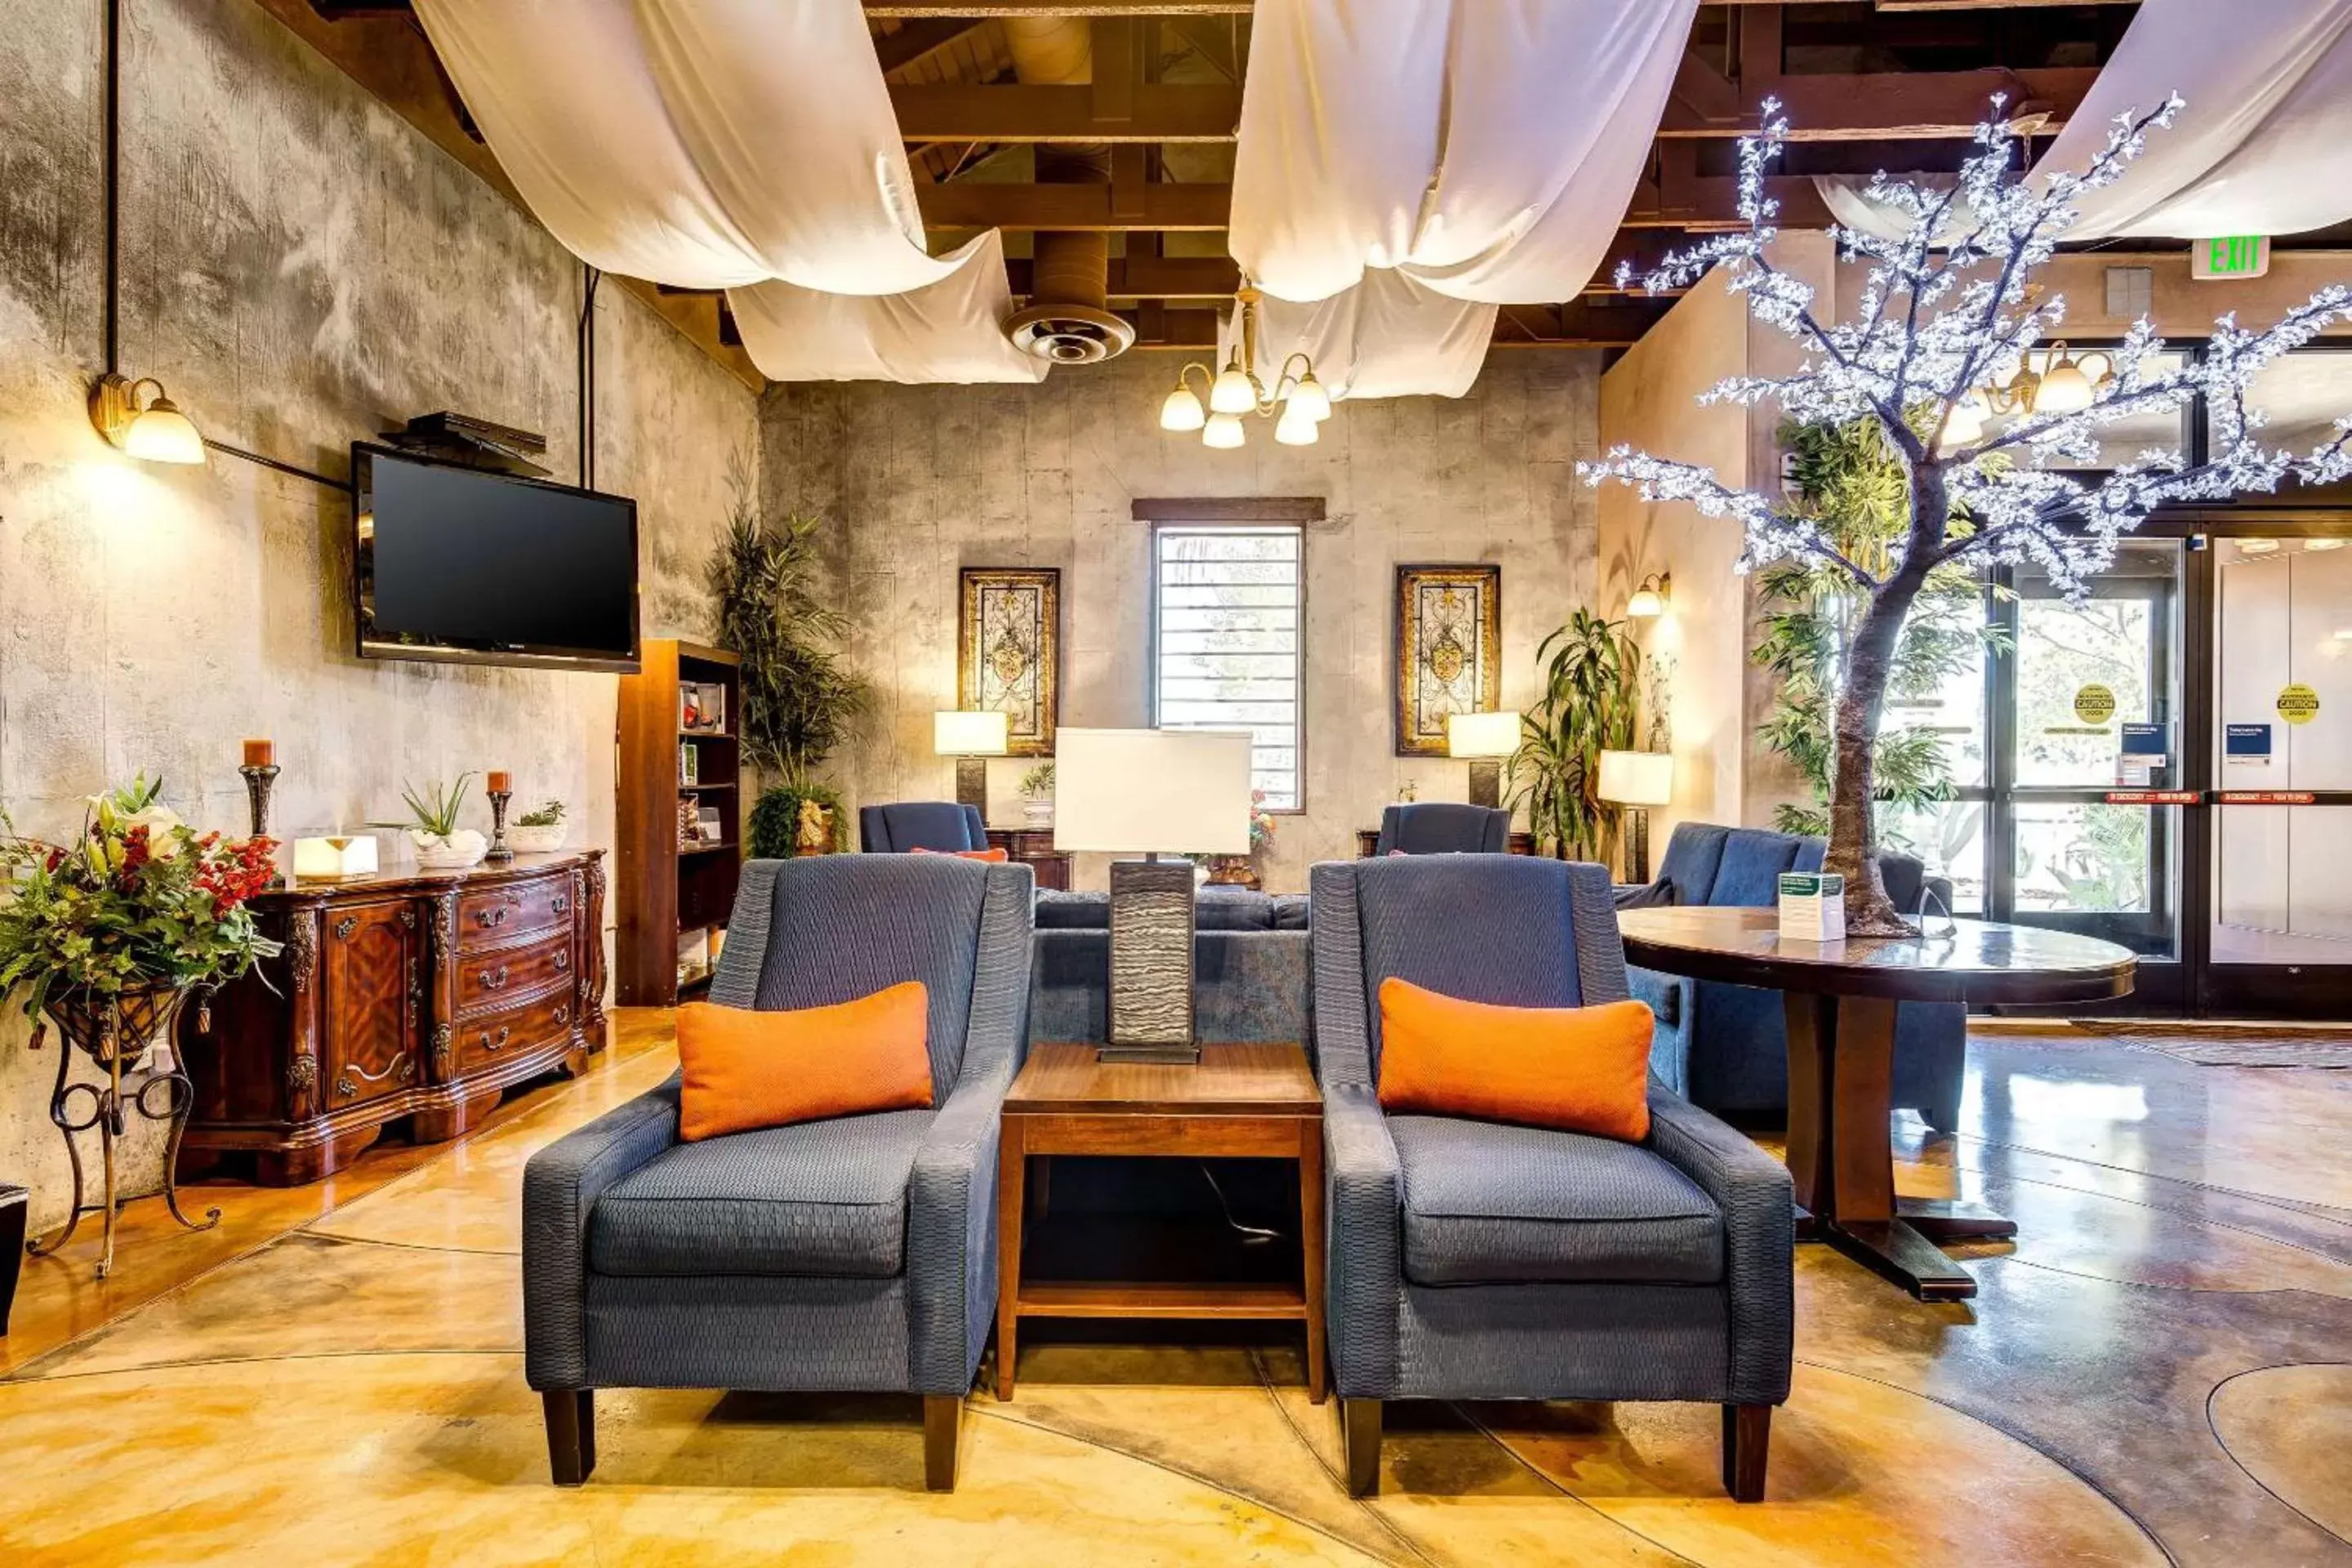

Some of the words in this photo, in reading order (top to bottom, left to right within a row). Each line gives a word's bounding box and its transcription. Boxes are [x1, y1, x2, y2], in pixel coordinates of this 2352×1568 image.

[2210, 236, 2260, 273] EXIT
[2077, 699, 2112, 708] CAUTION
[2280, 700, 2316, 708] CAUTION
